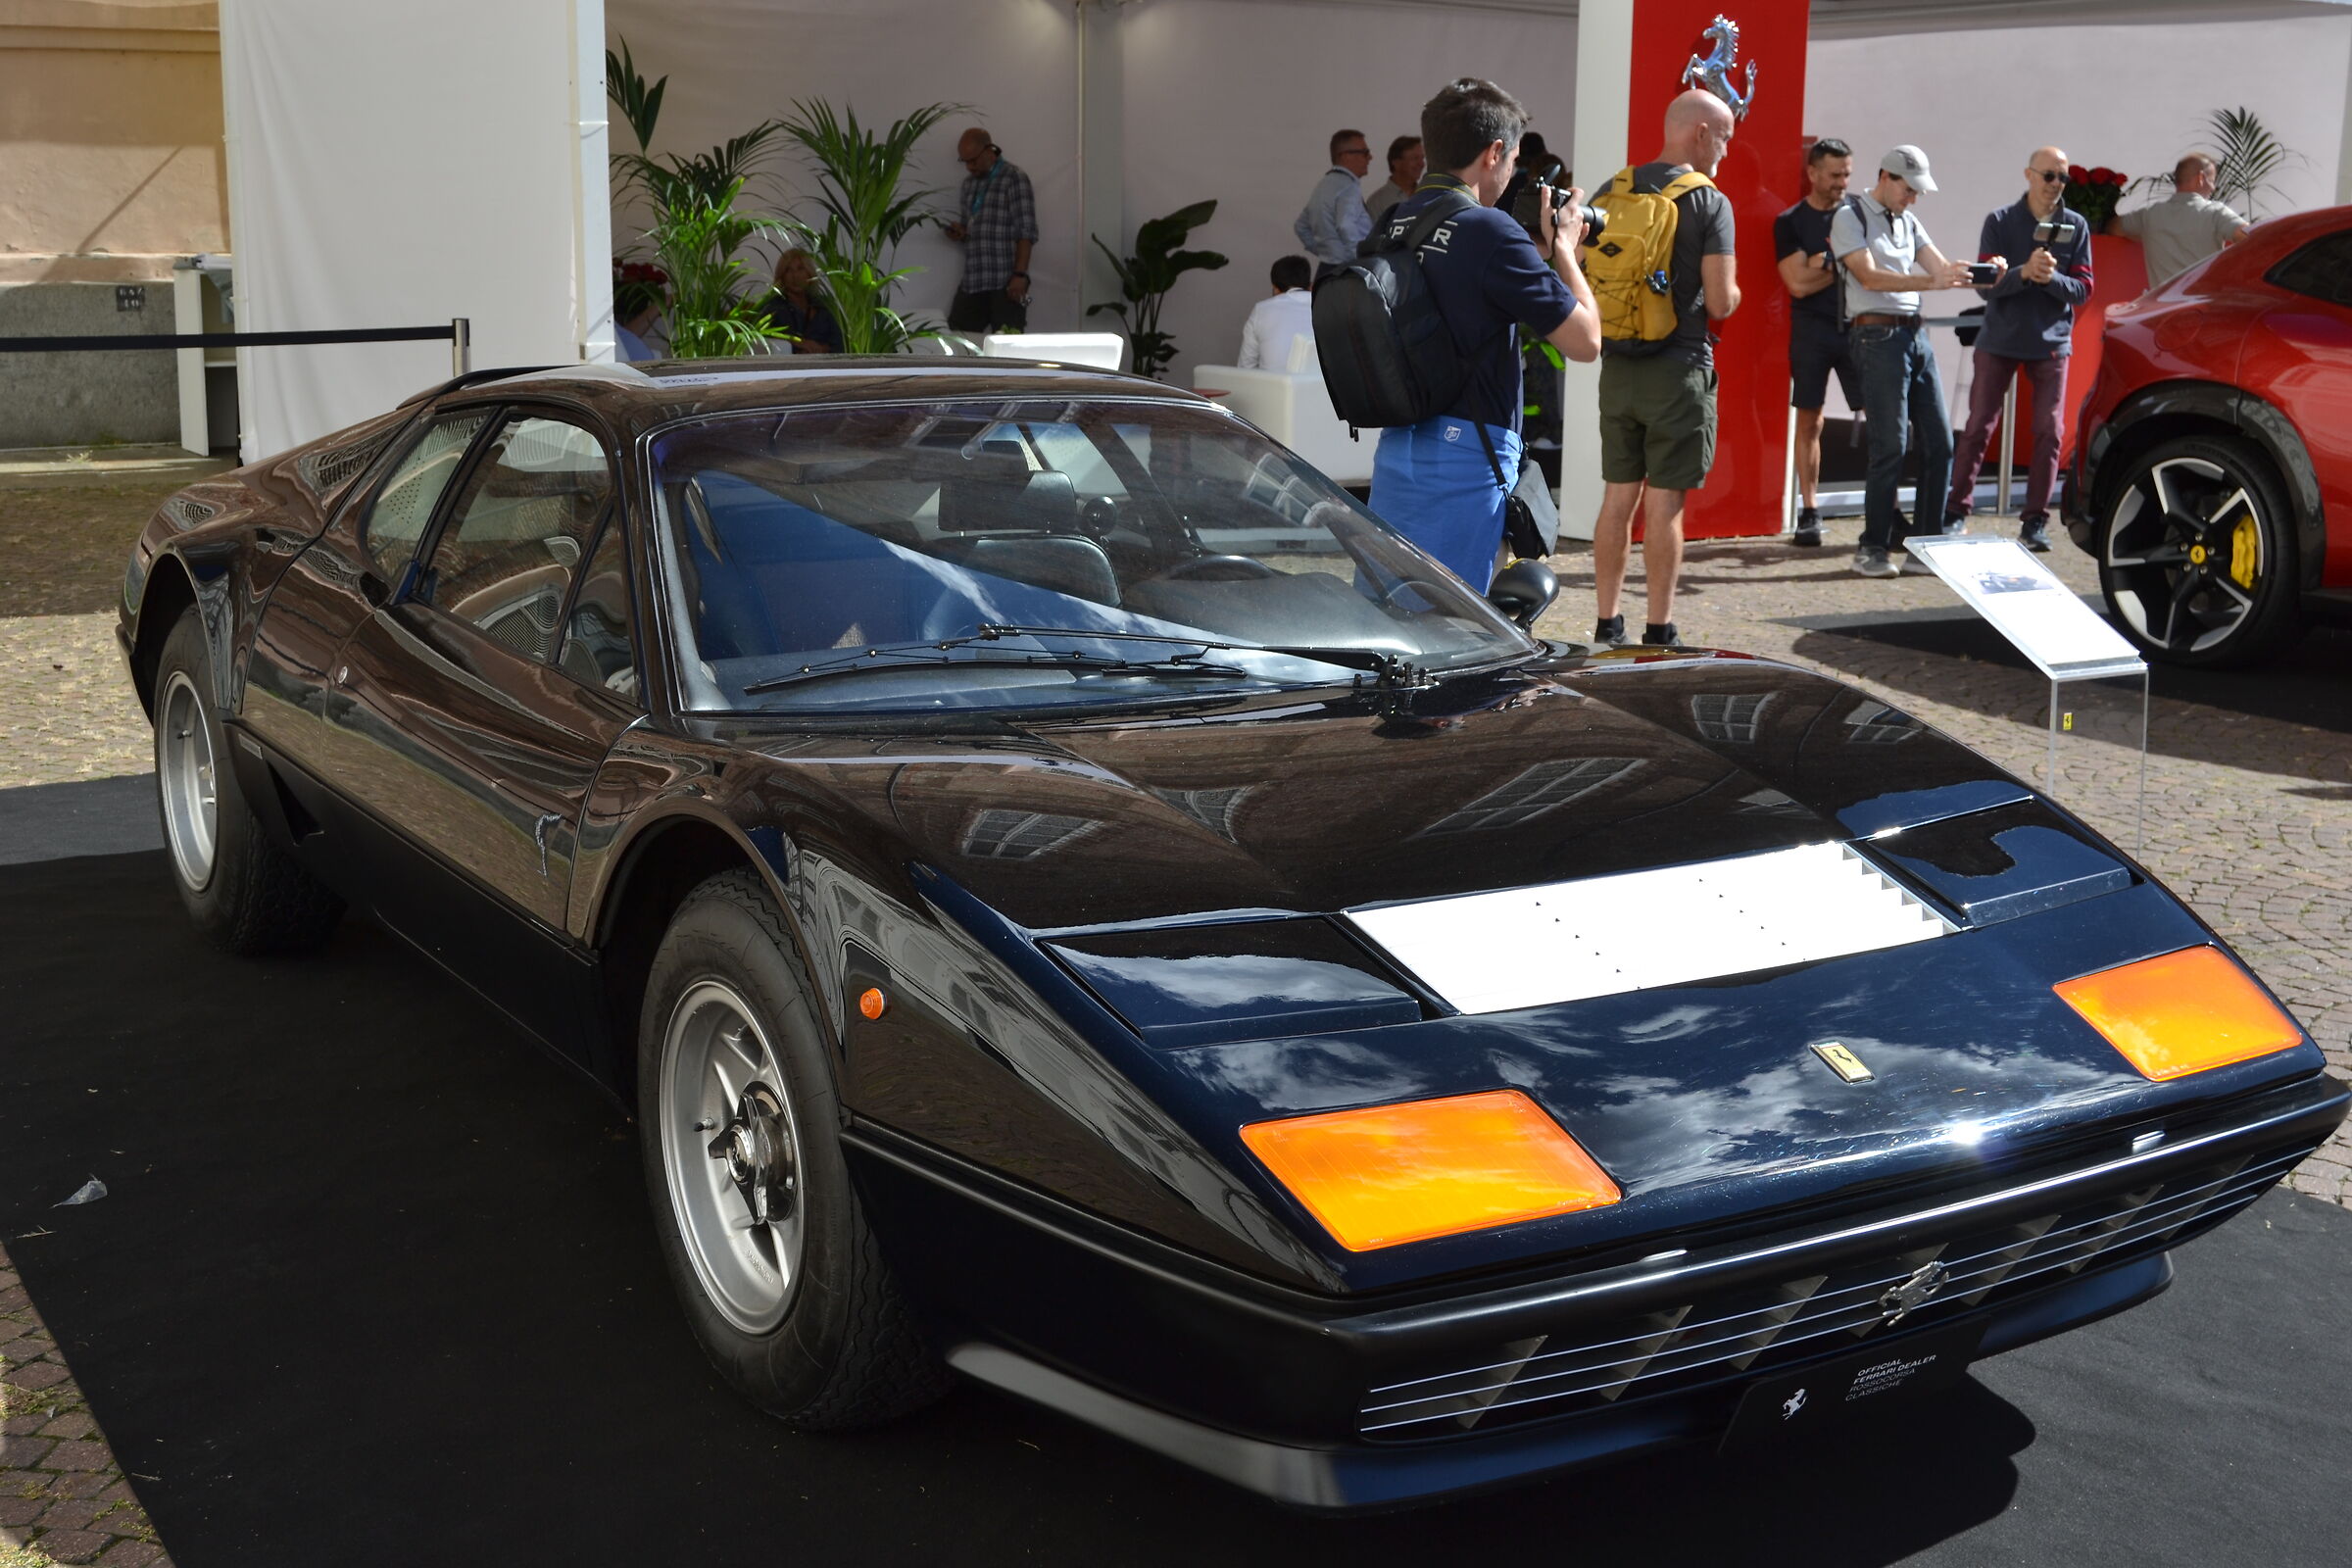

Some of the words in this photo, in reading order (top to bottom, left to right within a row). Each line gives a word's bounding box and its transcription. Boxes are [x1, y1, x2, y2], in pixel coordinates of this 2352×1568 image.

[1853, 1367, 1897, 1385] FERRARI
[1897, 1354, 1936, 1371] DEALER
[1858, 1358, 1902, 1377] OFFICIAL
[1845, 1379, 1902, 1401] CLASSICHE
